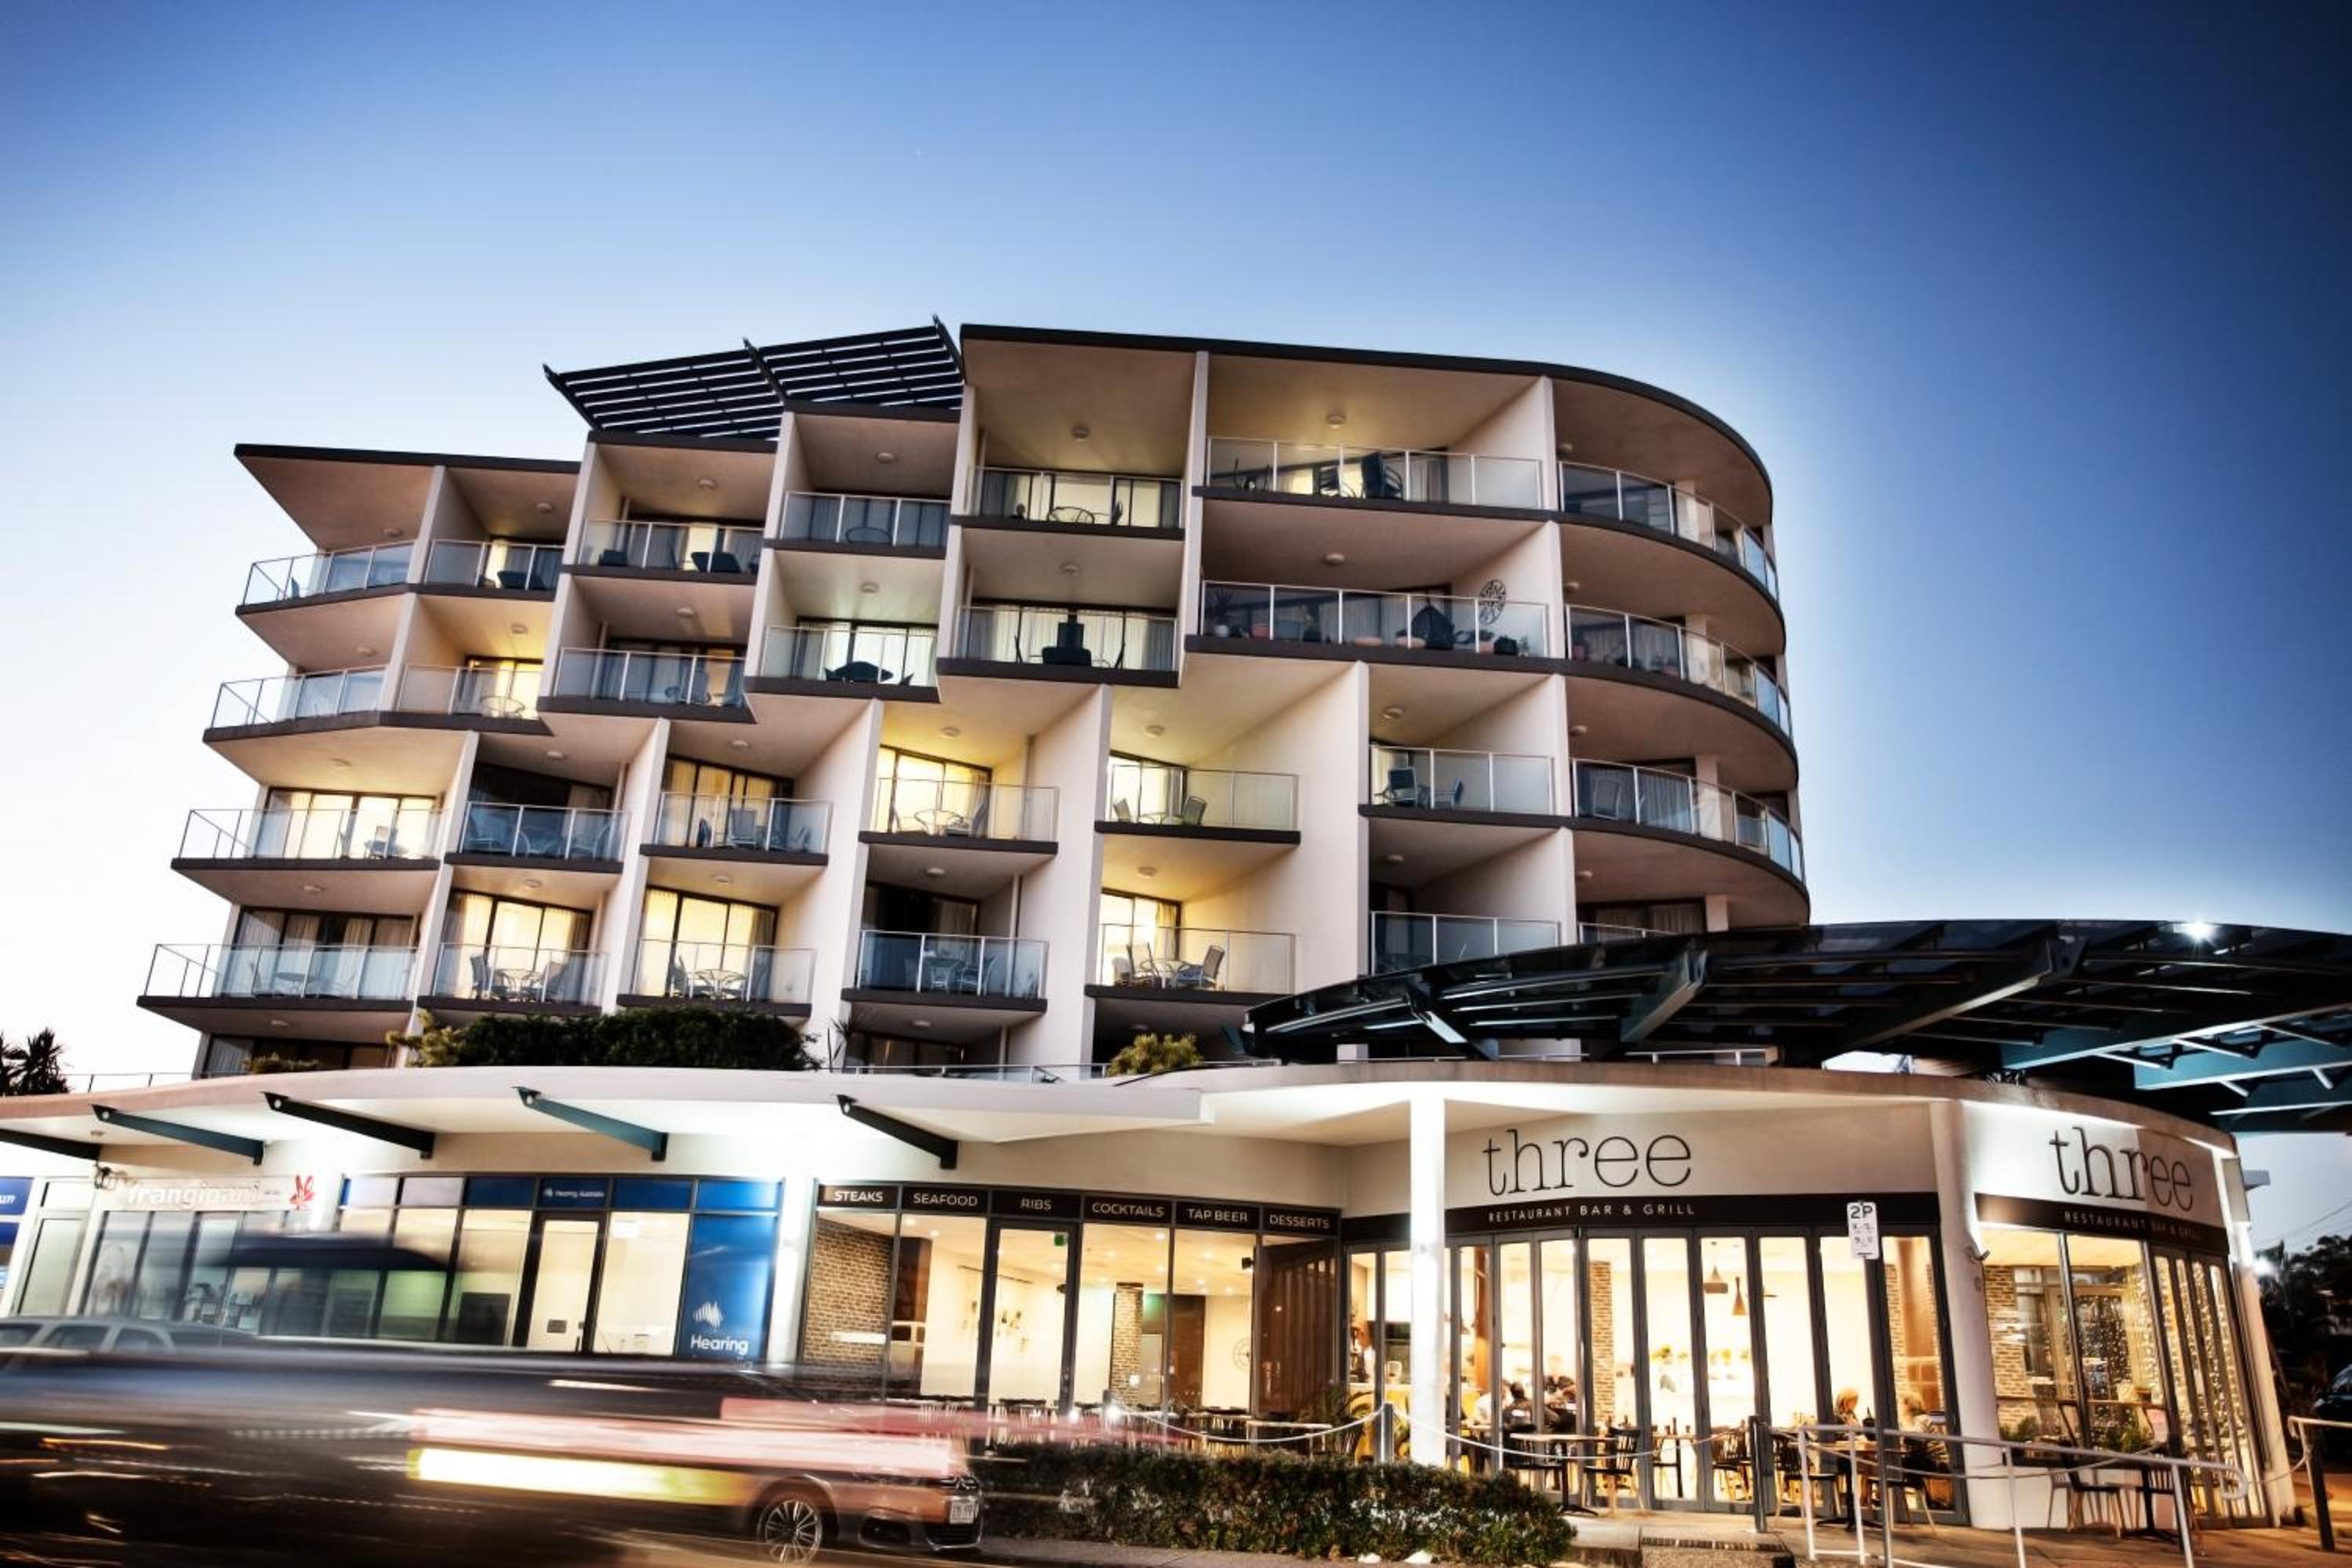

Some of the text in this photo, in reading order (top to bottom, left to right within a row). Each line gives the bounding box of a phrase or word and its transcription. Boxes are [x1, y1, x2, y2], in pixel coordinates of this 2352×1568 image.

[1483, 1129, 1691, 1196] three
[2049, 1127, 2193, 1211] three
[833, 1191, 884, 1203] STEAKS
[913, 1192, 978, 1207] SEAFOOD
[1021, 1198, 1052, 1210] RIBS
[1092, 1203, 1164, 1218] COCKTAILS
[1187, 1208, 1248, 1223] TAP BEER
[1489, 1203, 1694, 1223] RESTAURANT BAR & GRILL
[1850, 1205, 1873, 1219] 2P
[1269, 1214, 1330, 1229] DESSERTS
[2064, 1210, 2147, 1229] RESTAURANT
[691, 1334, 750, 1356] Hearing
